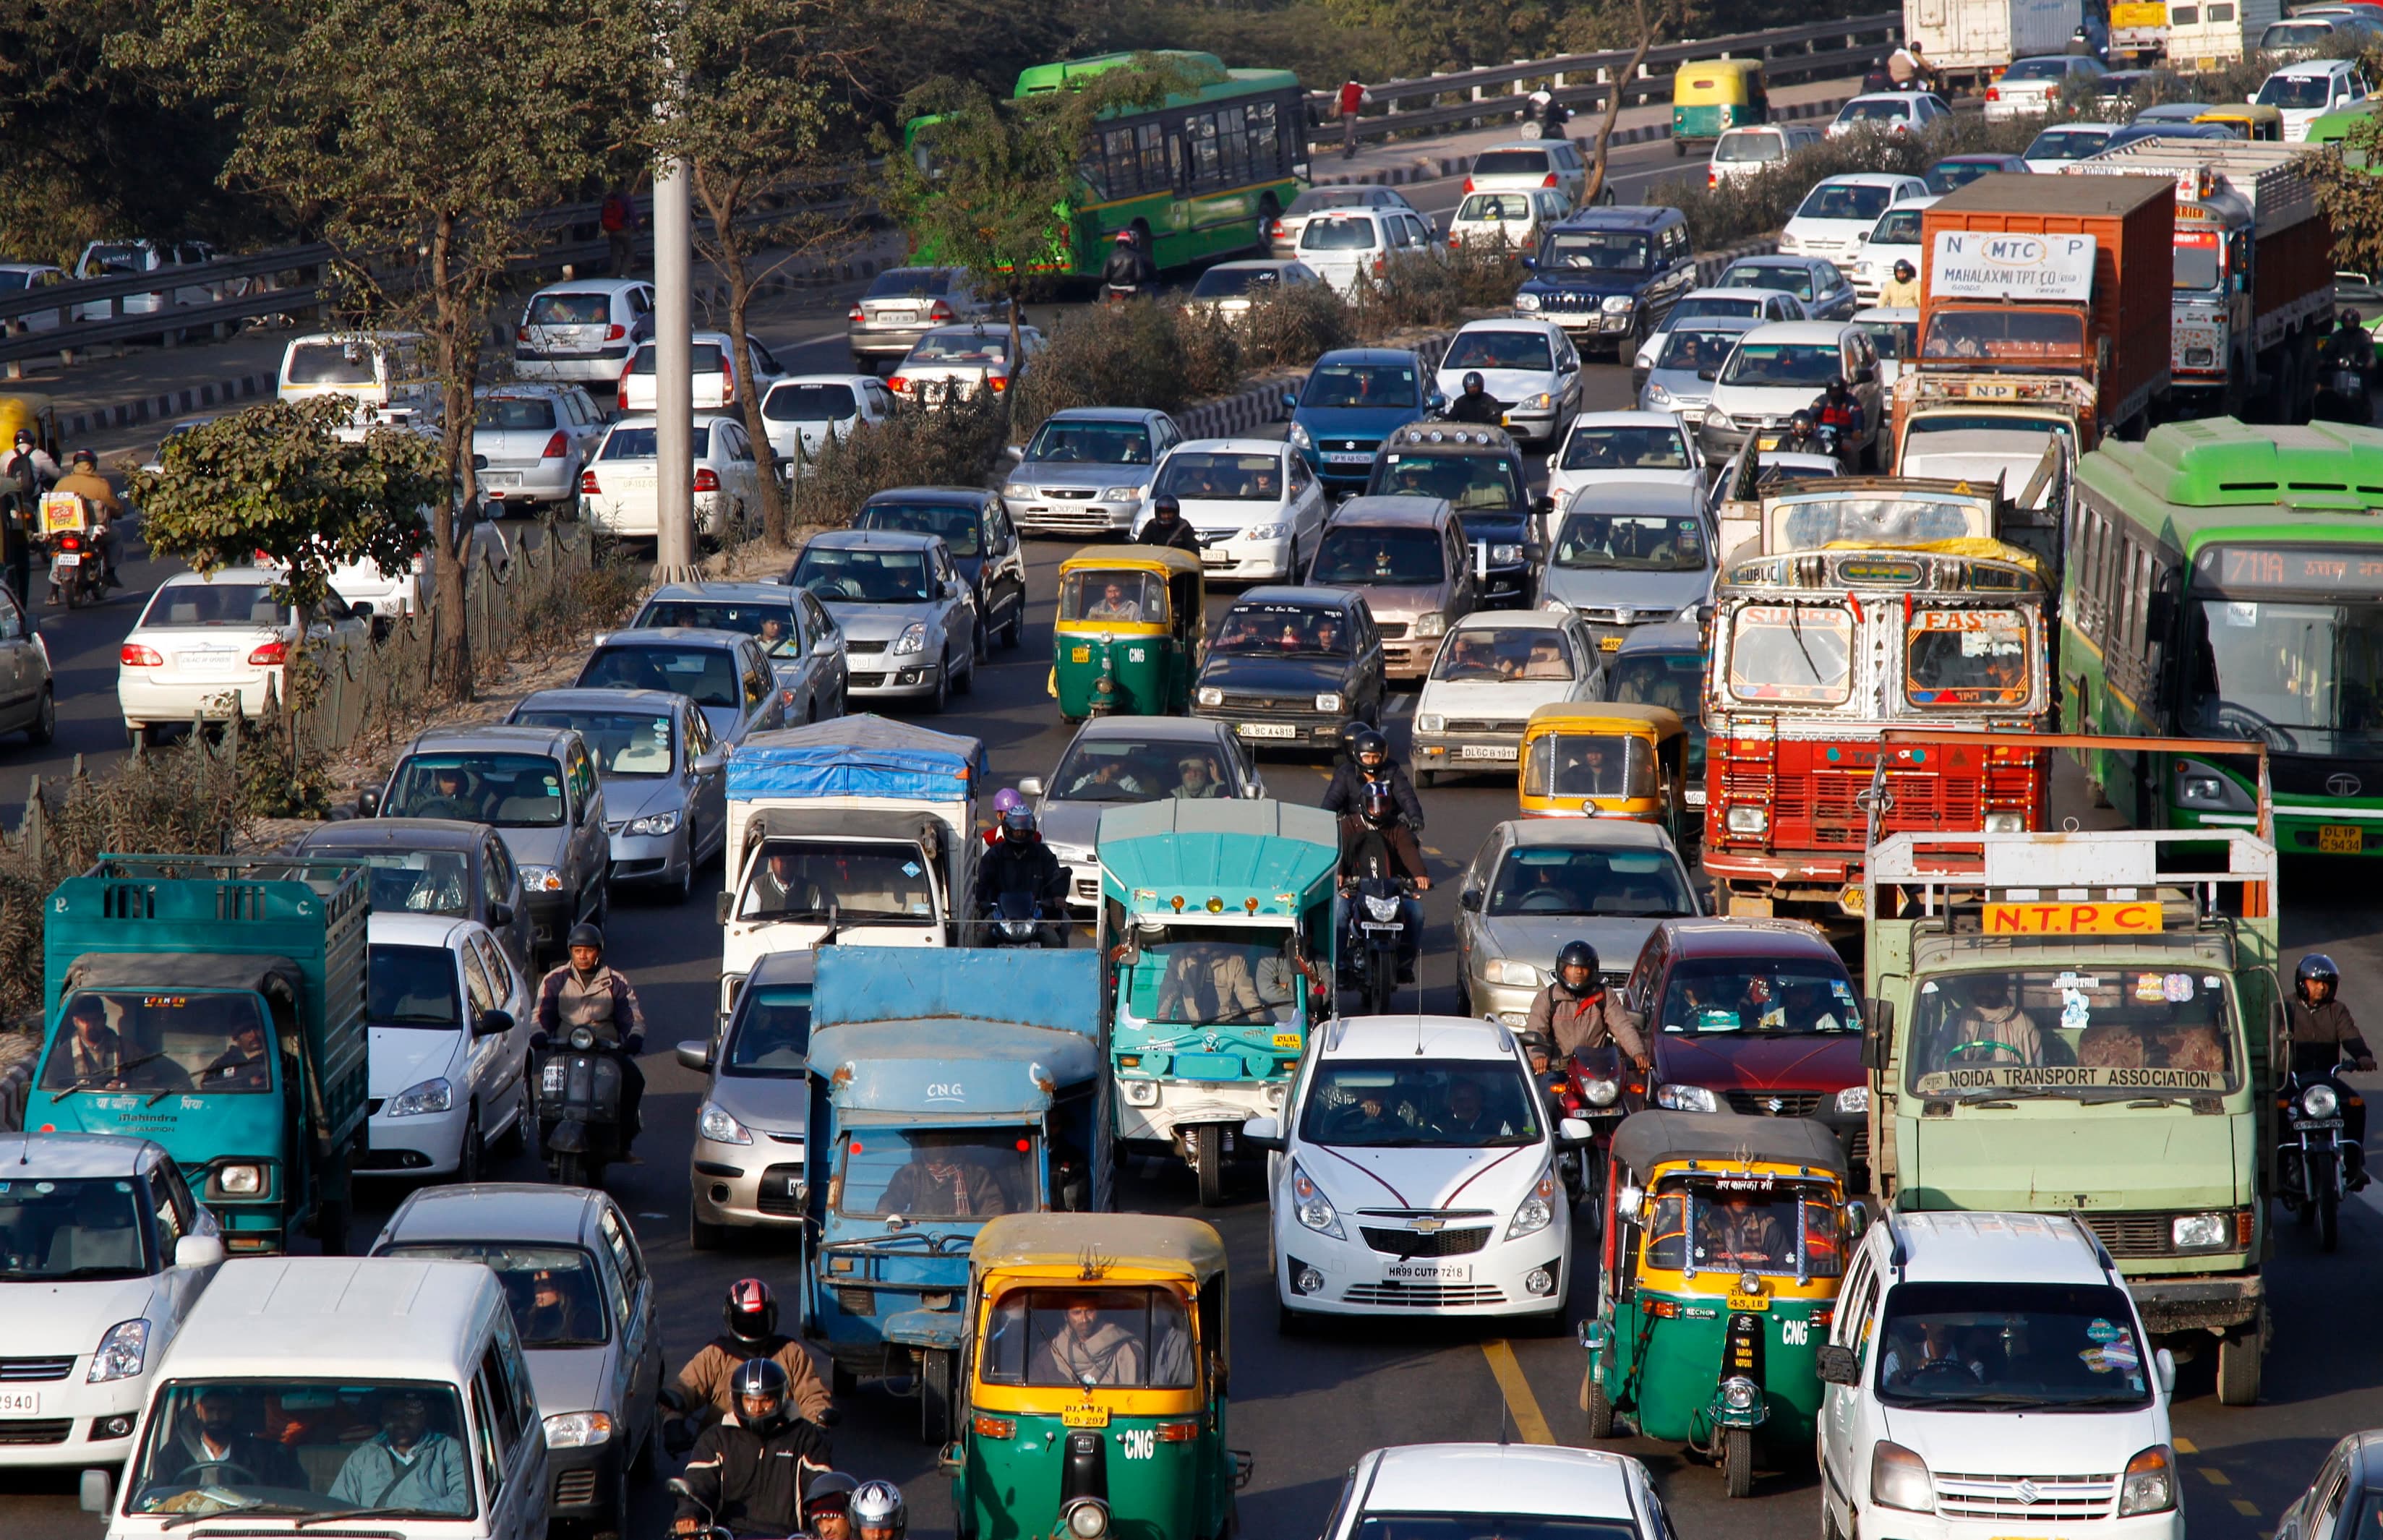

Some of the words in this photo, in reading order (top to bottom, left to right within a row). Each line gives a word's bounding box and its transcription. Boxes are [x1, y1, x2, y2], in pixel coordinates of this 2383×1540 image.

[1946, 236, 1963, 253] N
[2068, 239, 2084, 255] P
[1991, 241, 2036, 259] MTC
[1944, 268, 2013, 284] MAHALAXMI
[1976, 385, 1988, 397] N
[1995, 386, 2008, 397] P
[1738, 566, 1779, 583] UBLIC
[2232, 550, 2285, 583] 711A
[1129, 648, 1145, 663] CNG
[1852, 751, 1899, 764] TAA
[55, 897, 70, 913] P.
[297, 900, 313, 916] C.
[1949, 1070, 1995, 1088] NOIDA
[2003, 1069, 2097, 1087] TRANSPORT
[2108, 1069, 2210, 1089] ASSOCIATION
[926, 1083, 965, 1098] CNG
[119, 1113, 178, 1123] Mahindra
[1716, 1180, 1731, 1191] जय
[2074, 1194, 2088, 1208] T
[1388, 1267, 1412, 1278] HR99
[1414, 1267, 1439, 1279] CUTP
[1441, 1266, 1463, 1279] 7218
[1782, 1319, 1808, 1346] CNG
[1124, 1429, 1155, 1460] CNG
